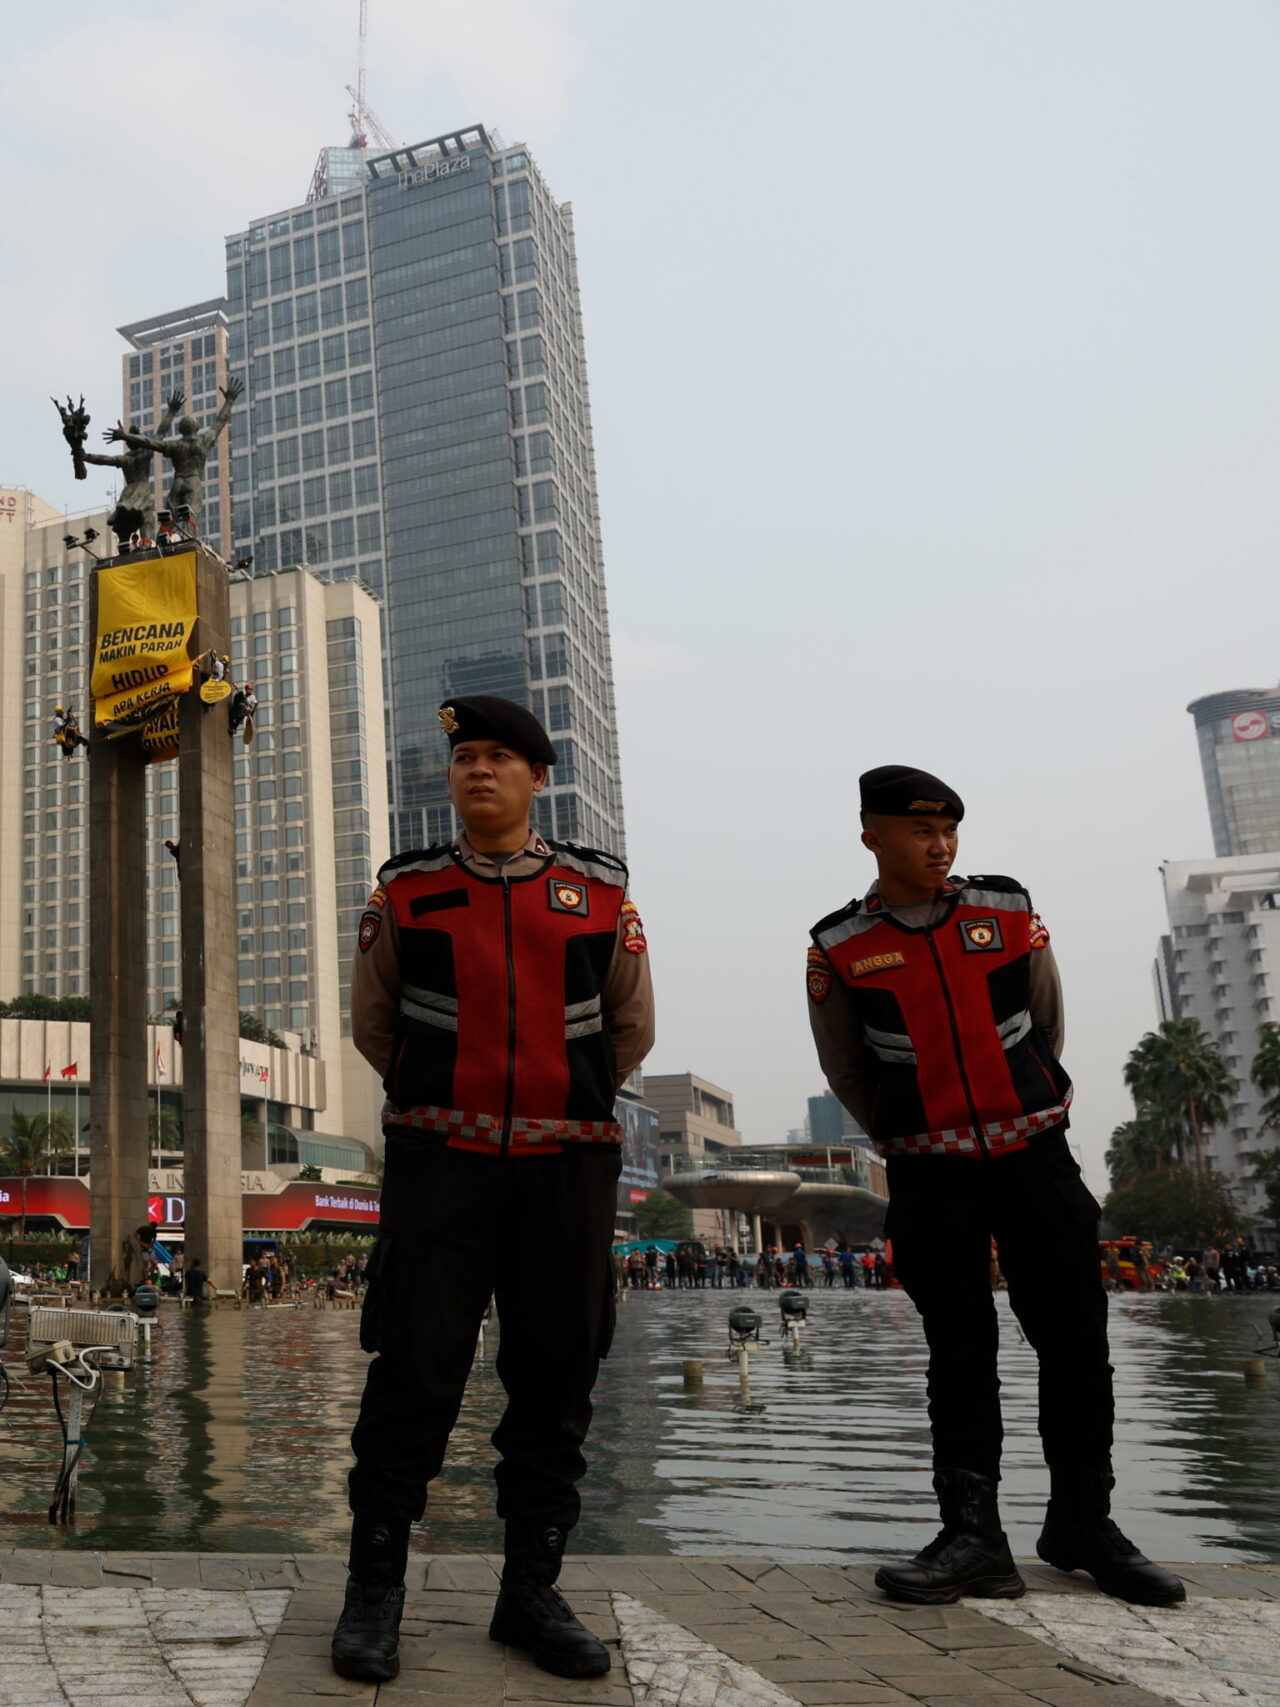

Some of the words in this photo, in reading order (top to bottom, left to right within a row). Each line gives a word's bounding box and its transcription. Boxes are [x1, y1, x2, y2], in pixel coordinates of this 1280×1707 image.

[101, 622, 185, 650] BENCANA
[100, 644, 136, 664] MAKIN
[140, 639, 182, 653] PARAH
[111, 664, 169, 690] HIDUP
[113, 697, 134, 717] APA
[136, 681, 171, 703] KERJA
[854, 952, 905, 974] ANGGA
[315, 1194, 330, 1207] Bank
[330, 1196, 348, 1209] Terbaik
[349, 1197, 354, 1209] di
[355, 1198, 368, 1211] Dunia
